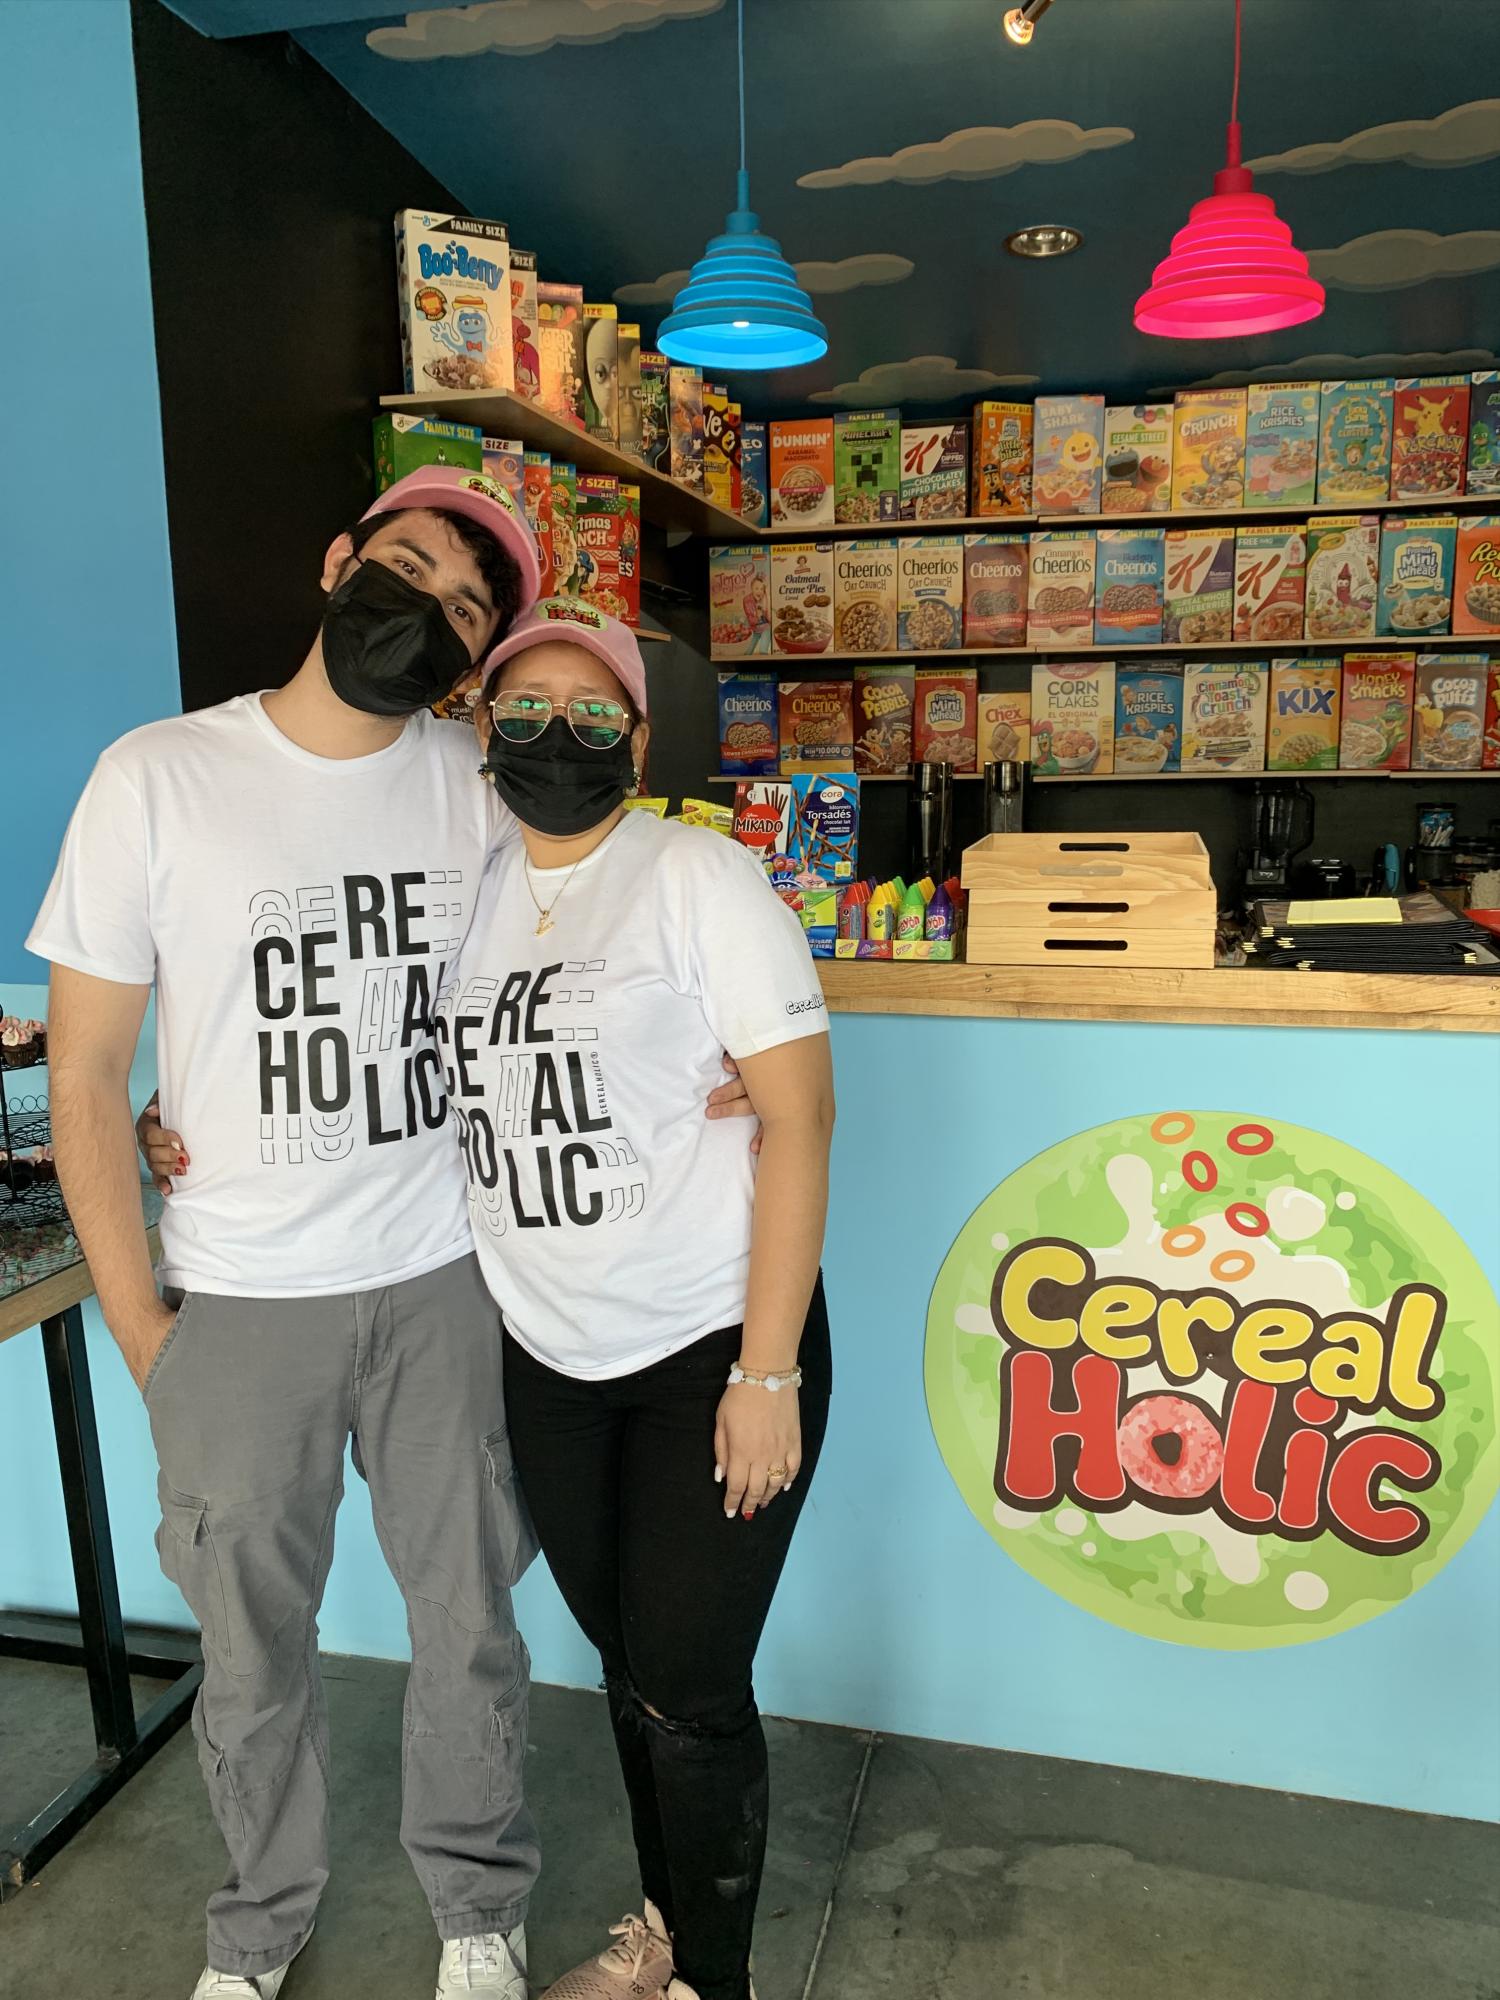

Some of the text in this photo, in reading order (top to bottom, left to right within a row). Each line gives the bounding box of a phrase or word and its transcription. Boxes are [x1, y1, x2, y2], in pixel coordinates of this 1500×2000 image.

[450, 219, 506, 240] FAMILY SIZE
[514, 257, 533, 268] SIZE
[640, 355, 667, 364] SIZE!
[1420, 376, 1465, 387] FAMILY SIZE
[1178, 394, 1216, 402] FAMILY
[991, 403, 1017, 412] FAMILY
[1041, 403, 1073, 417] BABY
[1270, 405, 1296, 417] RICE
[849, 412, 885, 421] FAMILY SIZE
[1043, 413, 1086, 429] SHARK
[1260, 416, 1304, 430] KRISPIES
[424, 420, 474, 440] FAMILY SIZE
[1180, 415, 1238, 437] CRUNCH
[773, 432, 831, 448] DUNKIN'
[843, 429, 893, 442] MINECRAFT
[1112, 431, 1165, 444] SESAME STREET
[485, 439, 509, 450] SIZE
[524, 453, 542, 464] SIZE
[904, 434, 940, 475] K
[552, 465, 569, 476] SIZE
[586, 478, 616, 489] SIZE!
[914, 470, 964, 487] CHOCOLATEY
[902, 479, 961, 498] DIPPED FLAKES
[1051, 531, 1089, 540] FAMILY SIZE
[1245, 526, 1275, 534] FAMILY
[1238, 538, 1259, 546] FREE
[903, 558, 959, 576] Cheerios
[1032, 556, 1092, 575] Cheerios
[1401, 552, 1436, 568] Mini
[838, 561, 893, 578] Cheerios
[970, 561, 1022, 578] Cheerios
[1105, 559, 1157, 576] Cheerios
[1168, 545, 1213, 593] K
[1398, 564, 1438, 580] Wheats
[785, 573, 821, 584] Oatmeal
[1237, 554, 1281, 599] K
[778, 583, 826, 595] Creme Pies
[1355, 672, 1401, 686] HONEY
[1432, 678, 1477, 694] Cocoa
[862, 683, 904, 700] COCOA
[1047, 680, 1099, 696] CORN
[1350, 683, 1407, 700] SMACKS
[1048, 695, 1099, 709] FLAKES
[1137, 691, 1166, 703] RICE
[1207, 689, 1242, 702] Toast
[724, 697, 772, 712] Cheerios
[792, 698, 841, 714] Cheerios
[861, 694, 909, 720] PEBBLES
[931, 700, 961, 712] Mini
[1126, 702, 1175, 716] KRISPIES
[1200, 695, 1252, 717] Crunch
[929, 711, 961, 722] Wheats
[985, 707, 1022, 723] Chex
[1058, 710, 1098, 718] ORIGINAL
[806, 809, 851, 820] Torsadés
[735, 816, 784, 833] MIKADO
[994, 1240, 1444, 1418] Cereal
